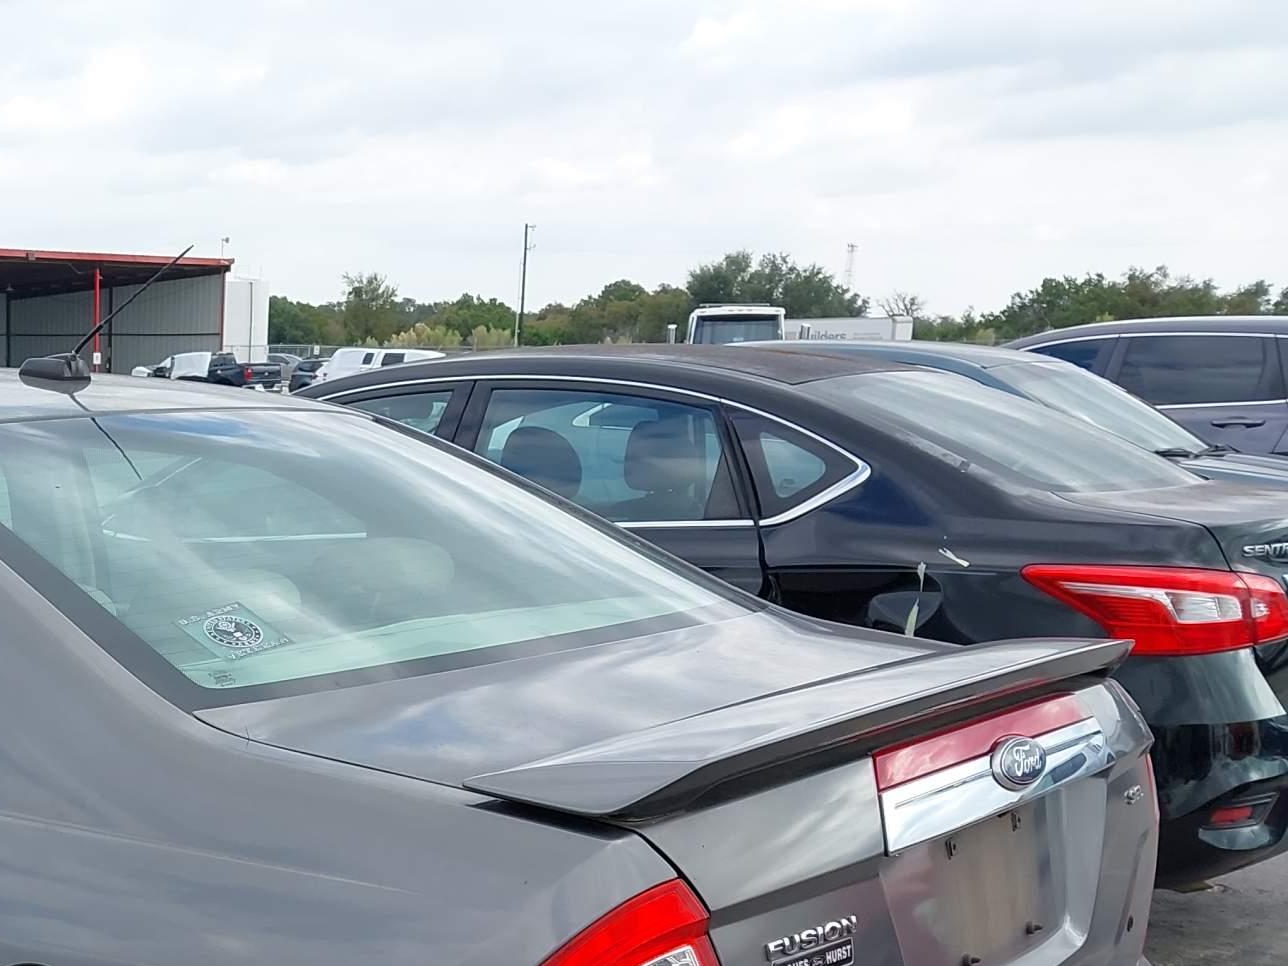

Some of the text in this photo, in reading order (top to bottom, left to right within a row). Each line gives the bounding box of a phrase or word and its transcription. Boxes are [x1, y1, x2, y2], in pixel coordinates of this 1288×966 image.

[1013, 744, 1042, 777] Ford
[766, 915, 857, 961] FUSION
[825, 944, 852, 965] HURST
